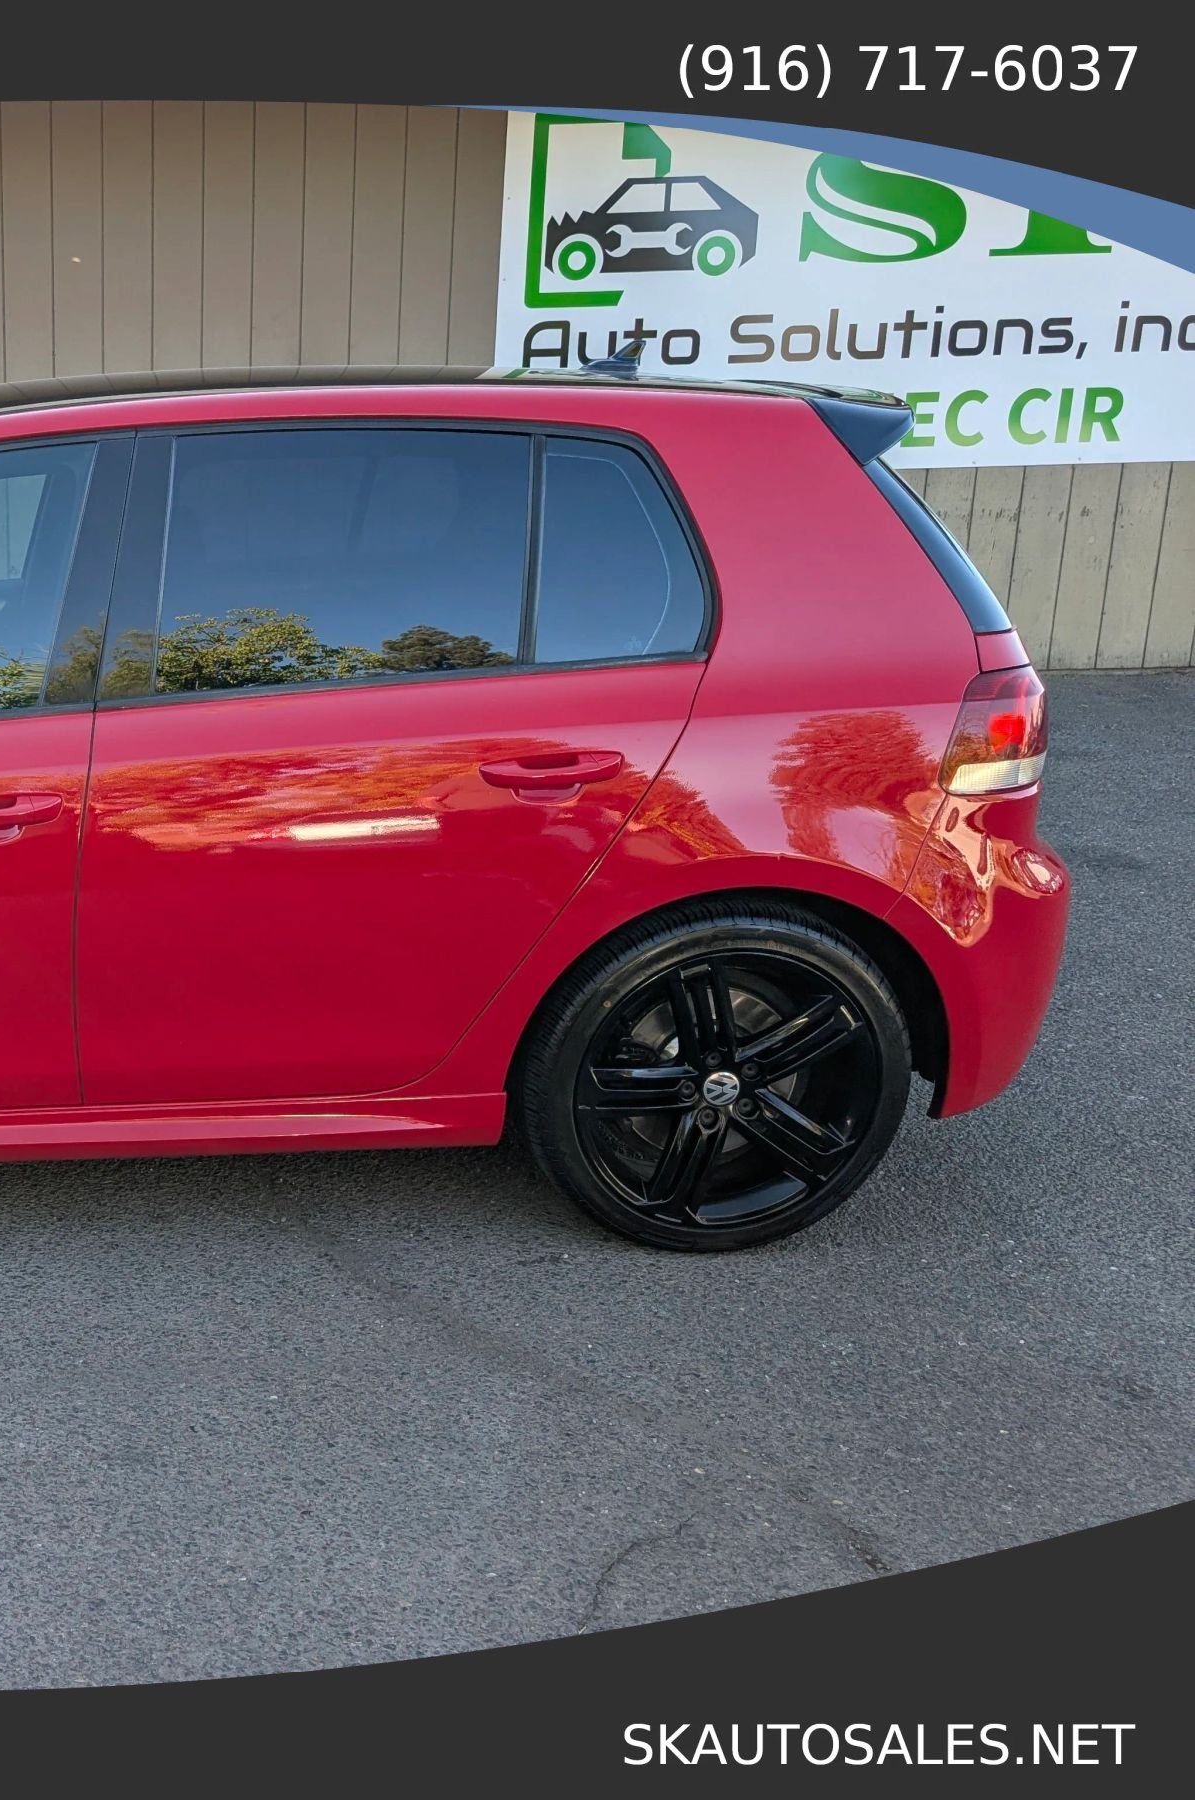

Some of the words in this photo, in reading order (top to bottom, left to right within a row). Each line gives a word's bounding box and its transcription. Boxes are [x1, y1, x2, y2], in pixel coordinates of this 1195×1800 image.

[727, 308, 1087, 366] Solutions,
[899, 389, 989, 448] EC
[1008, 386, 1124, 446] CIR
[704, 1072, 740, 1106] VW
